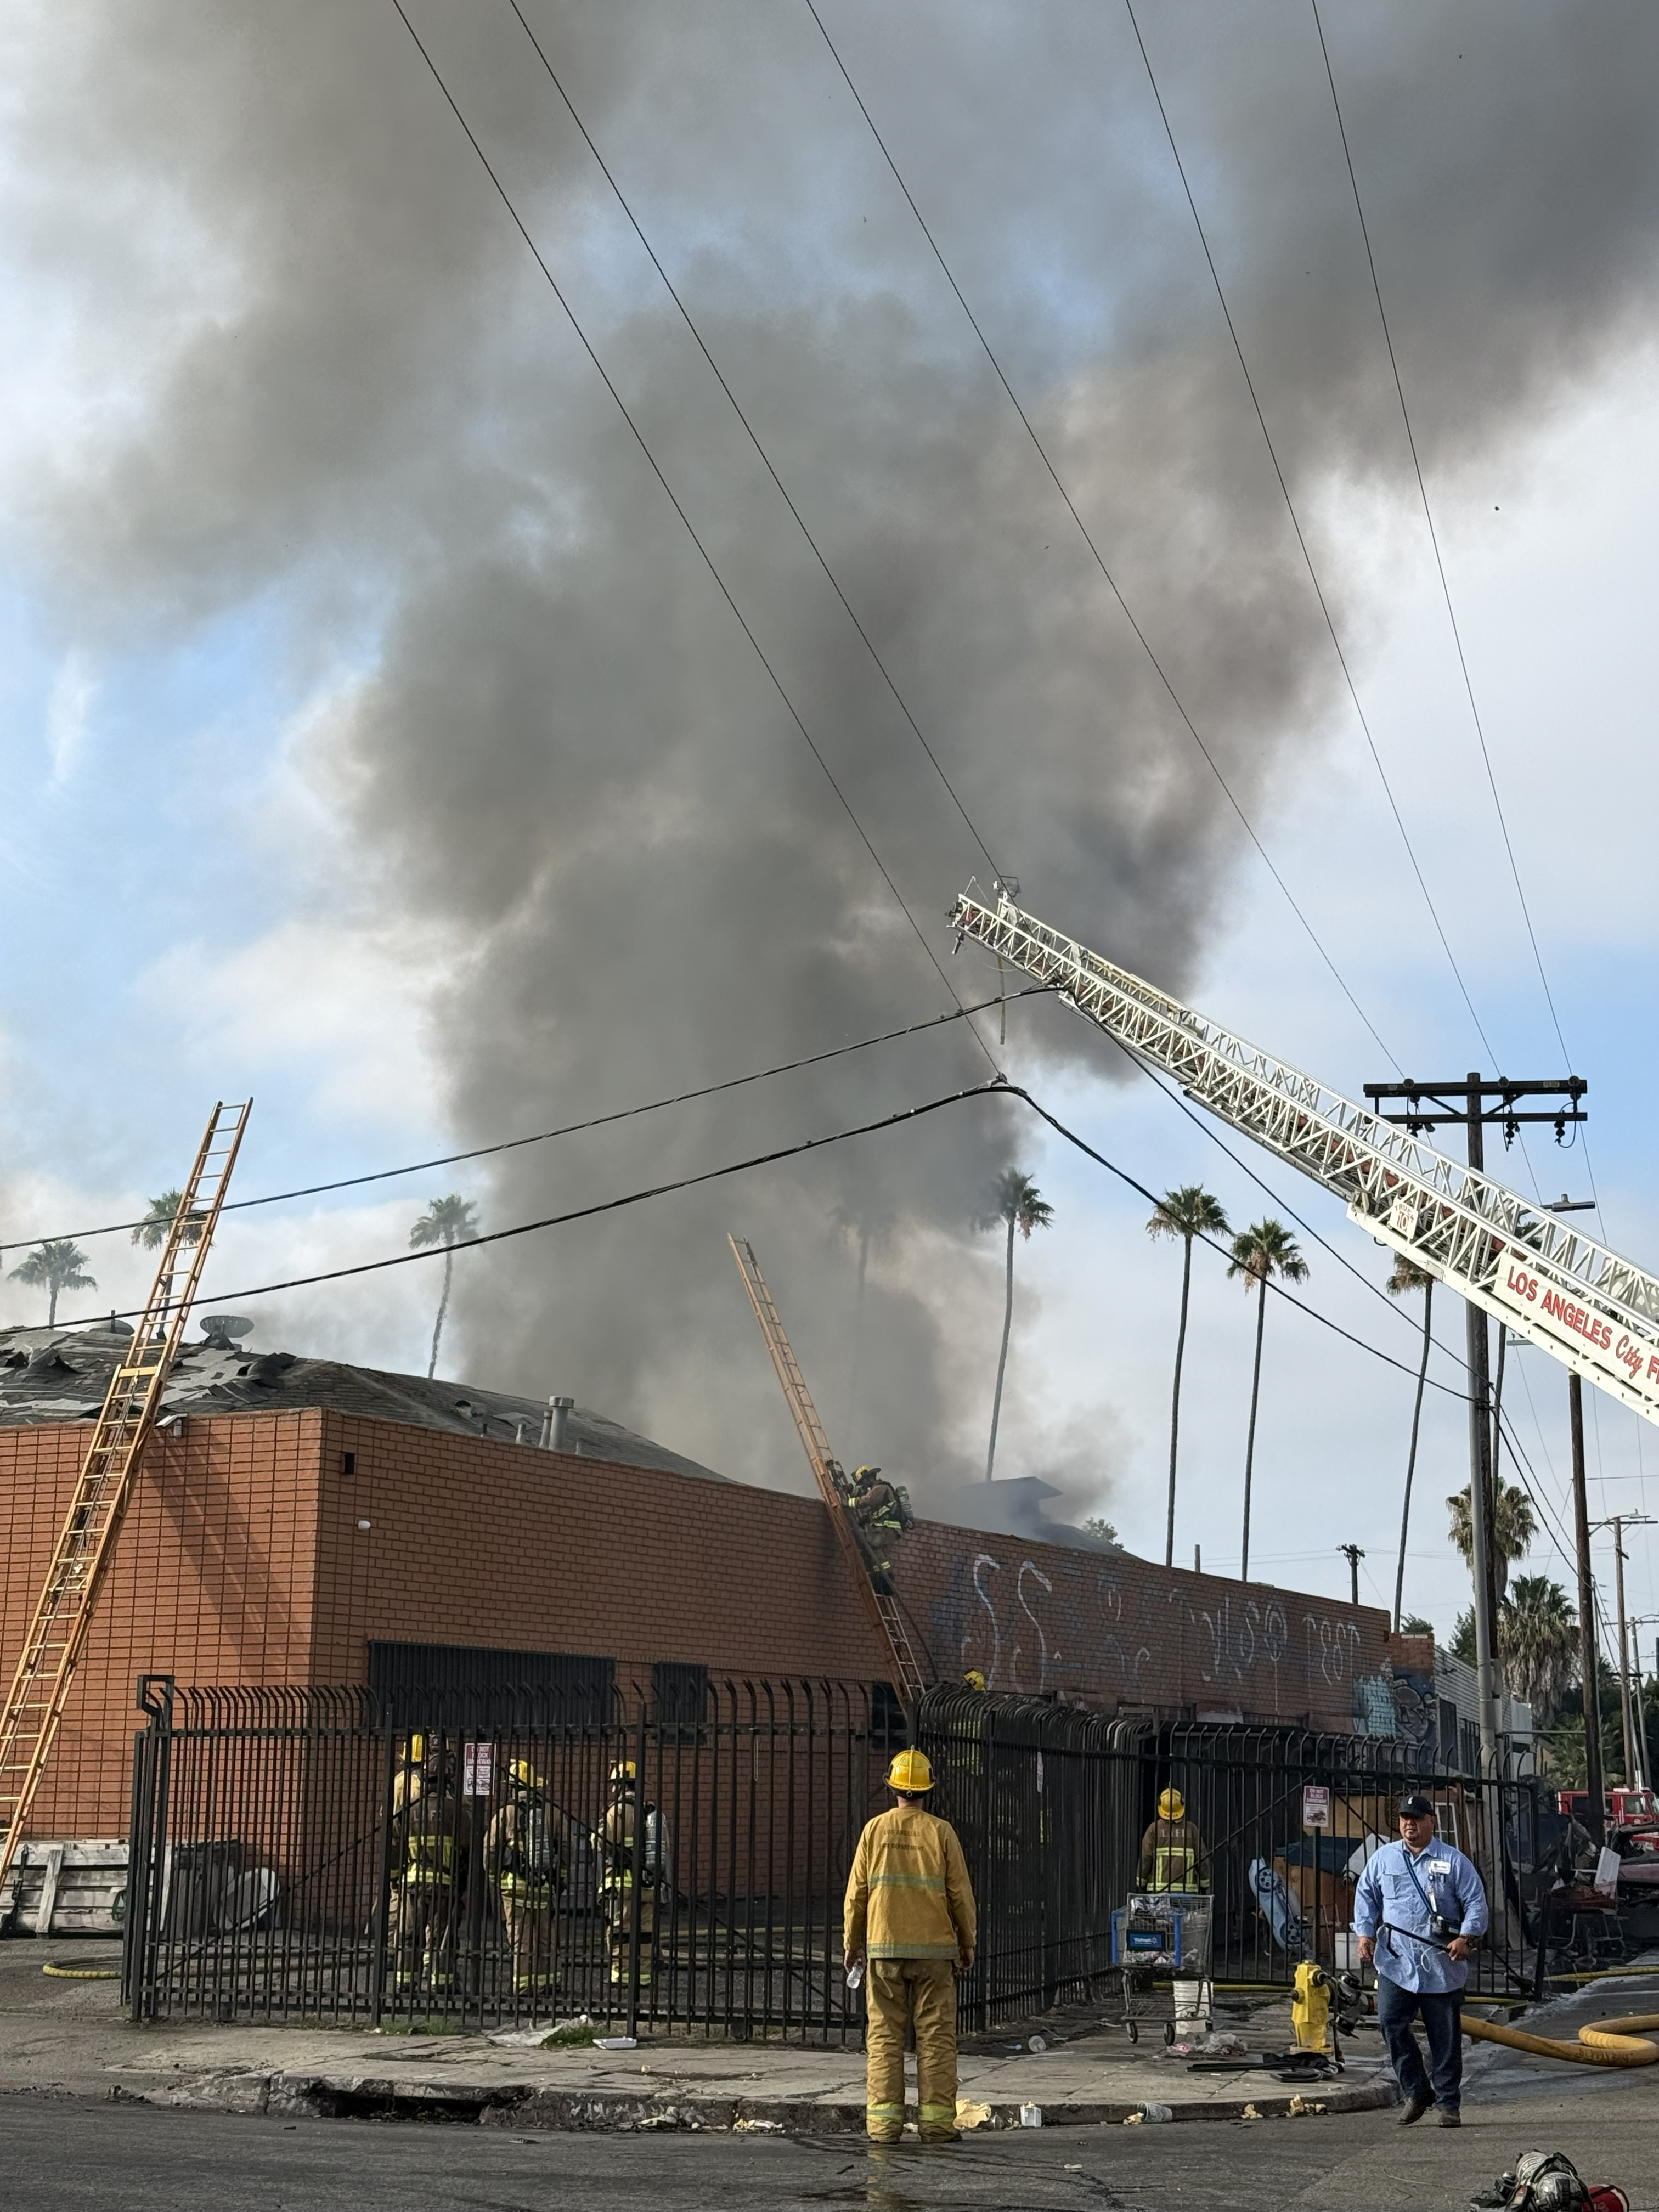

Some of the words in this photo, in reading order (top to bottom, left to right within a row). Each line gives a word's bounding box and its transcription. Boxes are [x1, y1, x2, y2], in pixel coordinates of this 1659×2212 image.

[1394, 1204, 1414, 1223] TRUCK
[1396, 1211, 1410, 1232] 10
[1507, 1266, 1538, 1301] LOS
[1541, 1289, 1613, 1350] ANGELES
[1616, 1335, 1644, 1379] City
